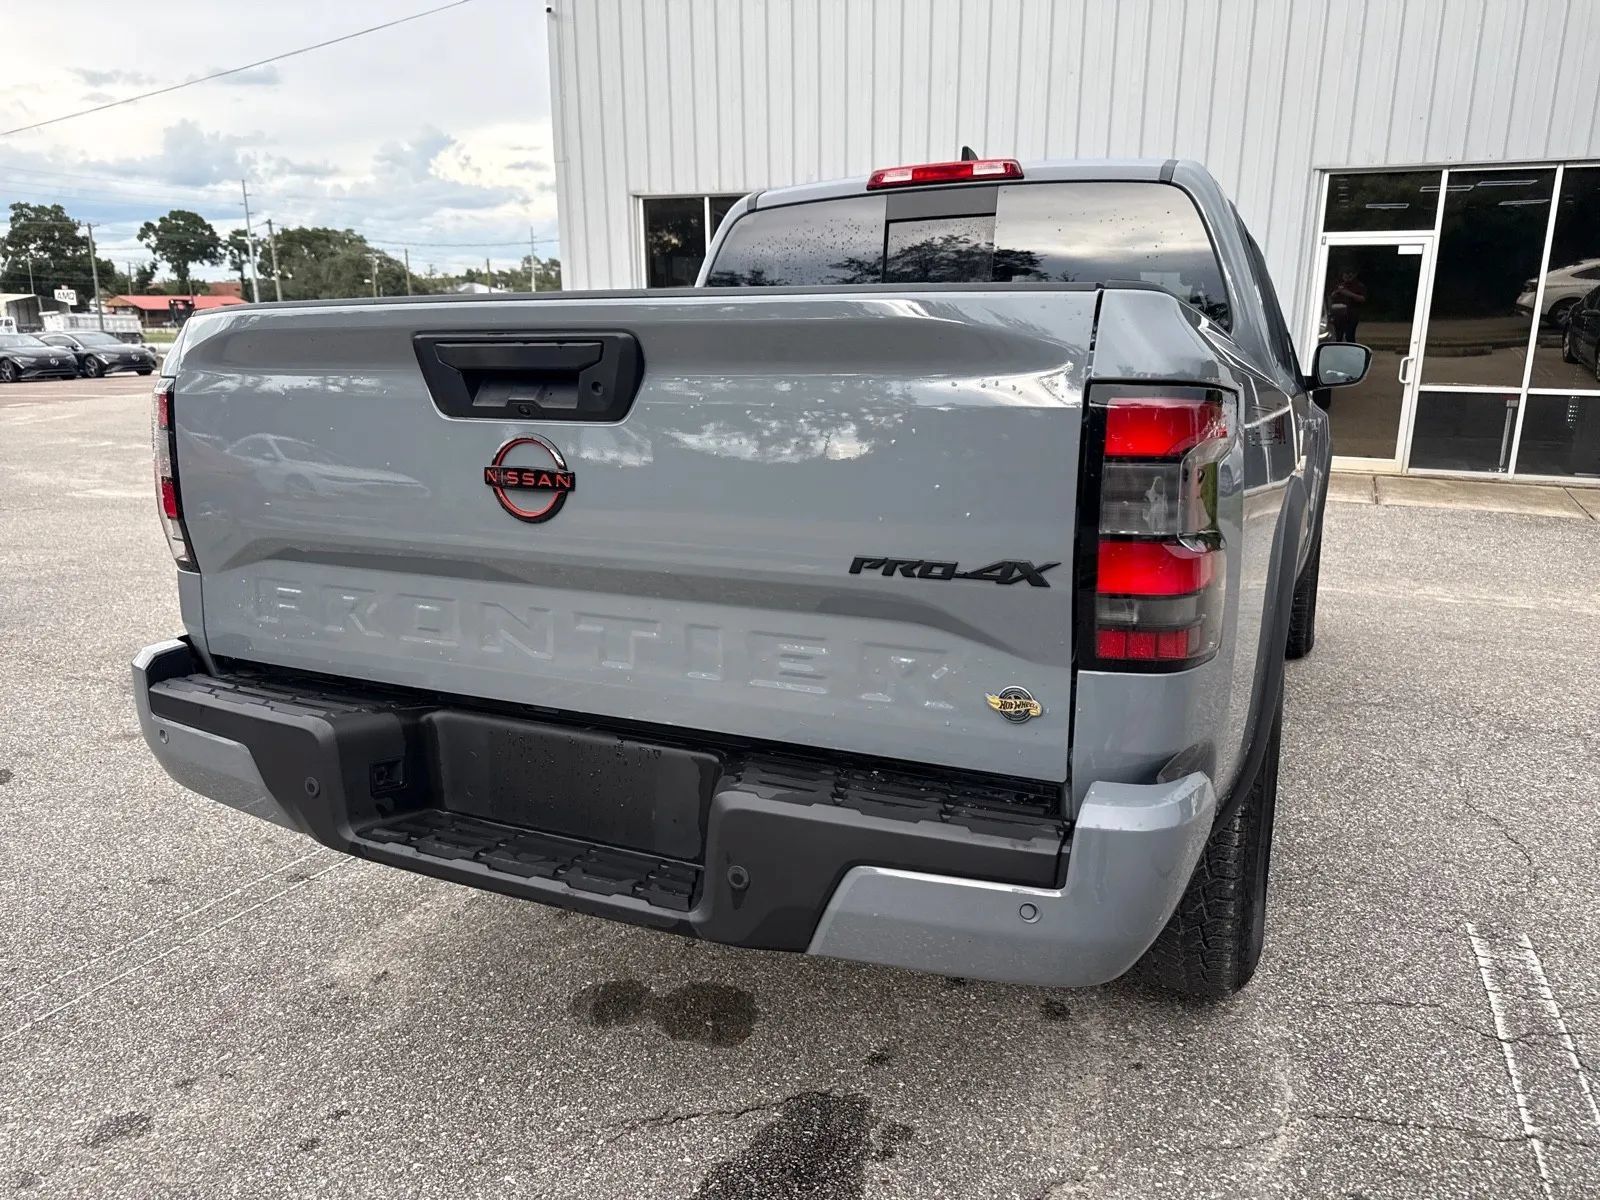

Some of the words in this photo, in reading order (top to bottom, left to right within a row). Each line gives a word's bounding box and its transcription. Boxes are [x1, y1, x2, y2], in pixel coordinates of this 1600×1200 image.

[486, 469, 571, 488] NISSAN
[849, 555, 1061, 587] PRO-4X
[254, 577, 955, 710] FRONTIER
